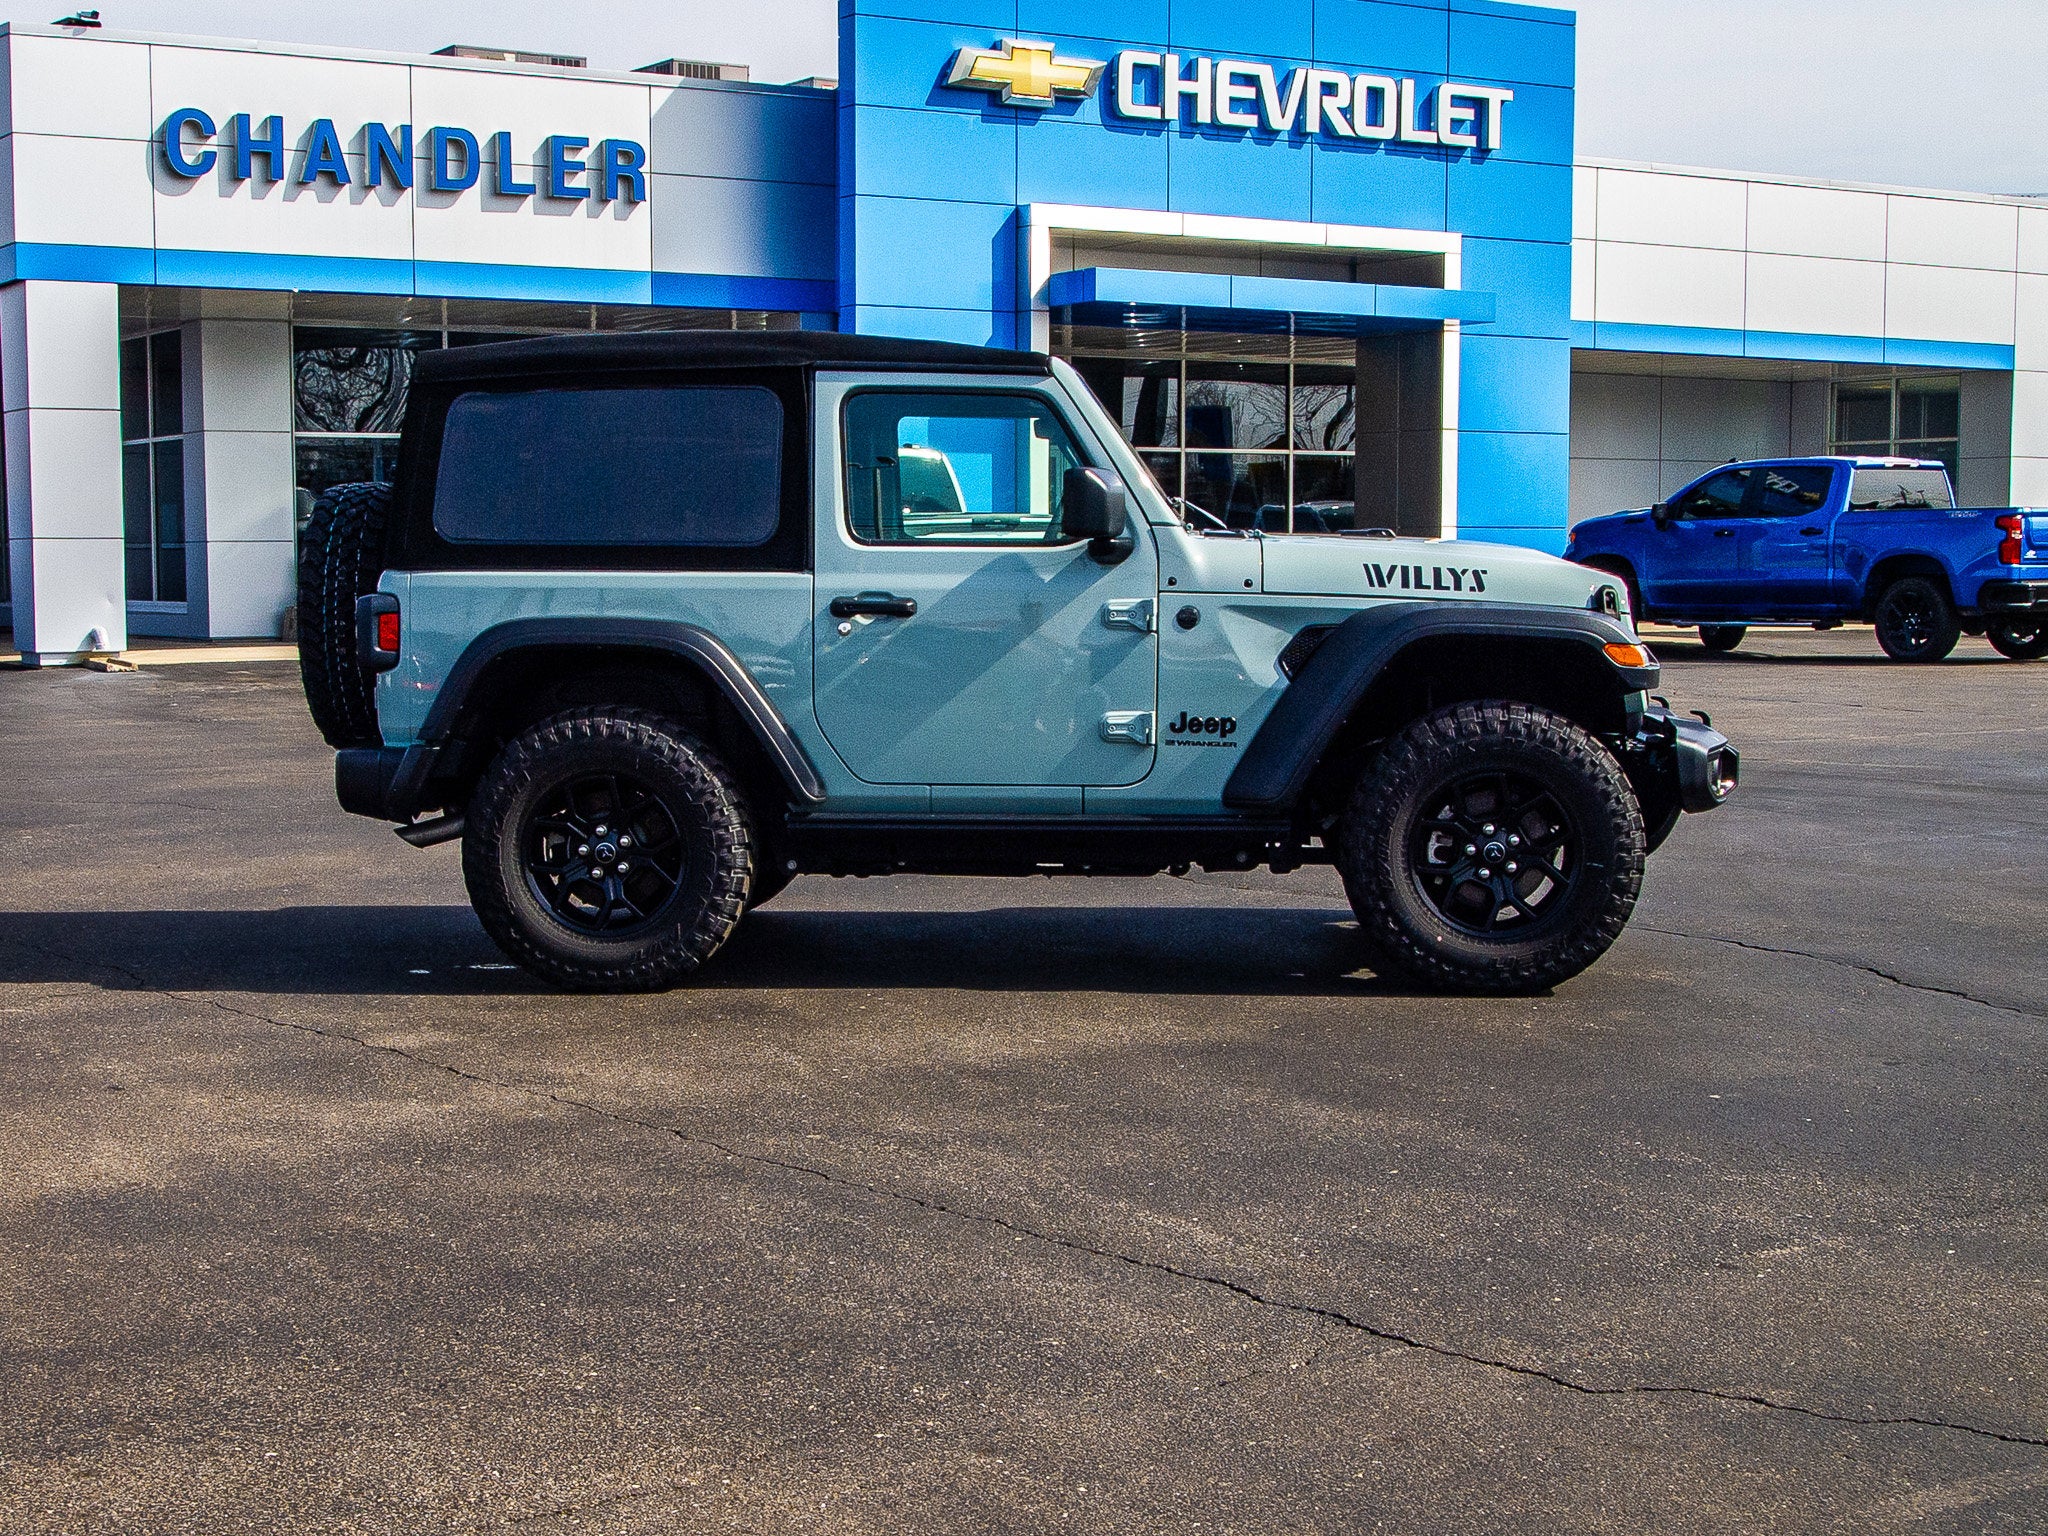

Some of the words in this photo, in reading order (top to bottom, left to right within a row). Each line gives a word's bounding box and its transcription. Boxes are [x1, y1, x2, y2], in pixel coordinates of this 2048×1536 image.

[1115, 51, 1514, 149] CHEVROLET
[164, 108, 646, 202] CHANDLER
[1362, 563, 1488, 593] WILLYS
[1169, 711, 1237, 738] Jeep
[1175, 740, 1238, 748] WRANGLER
